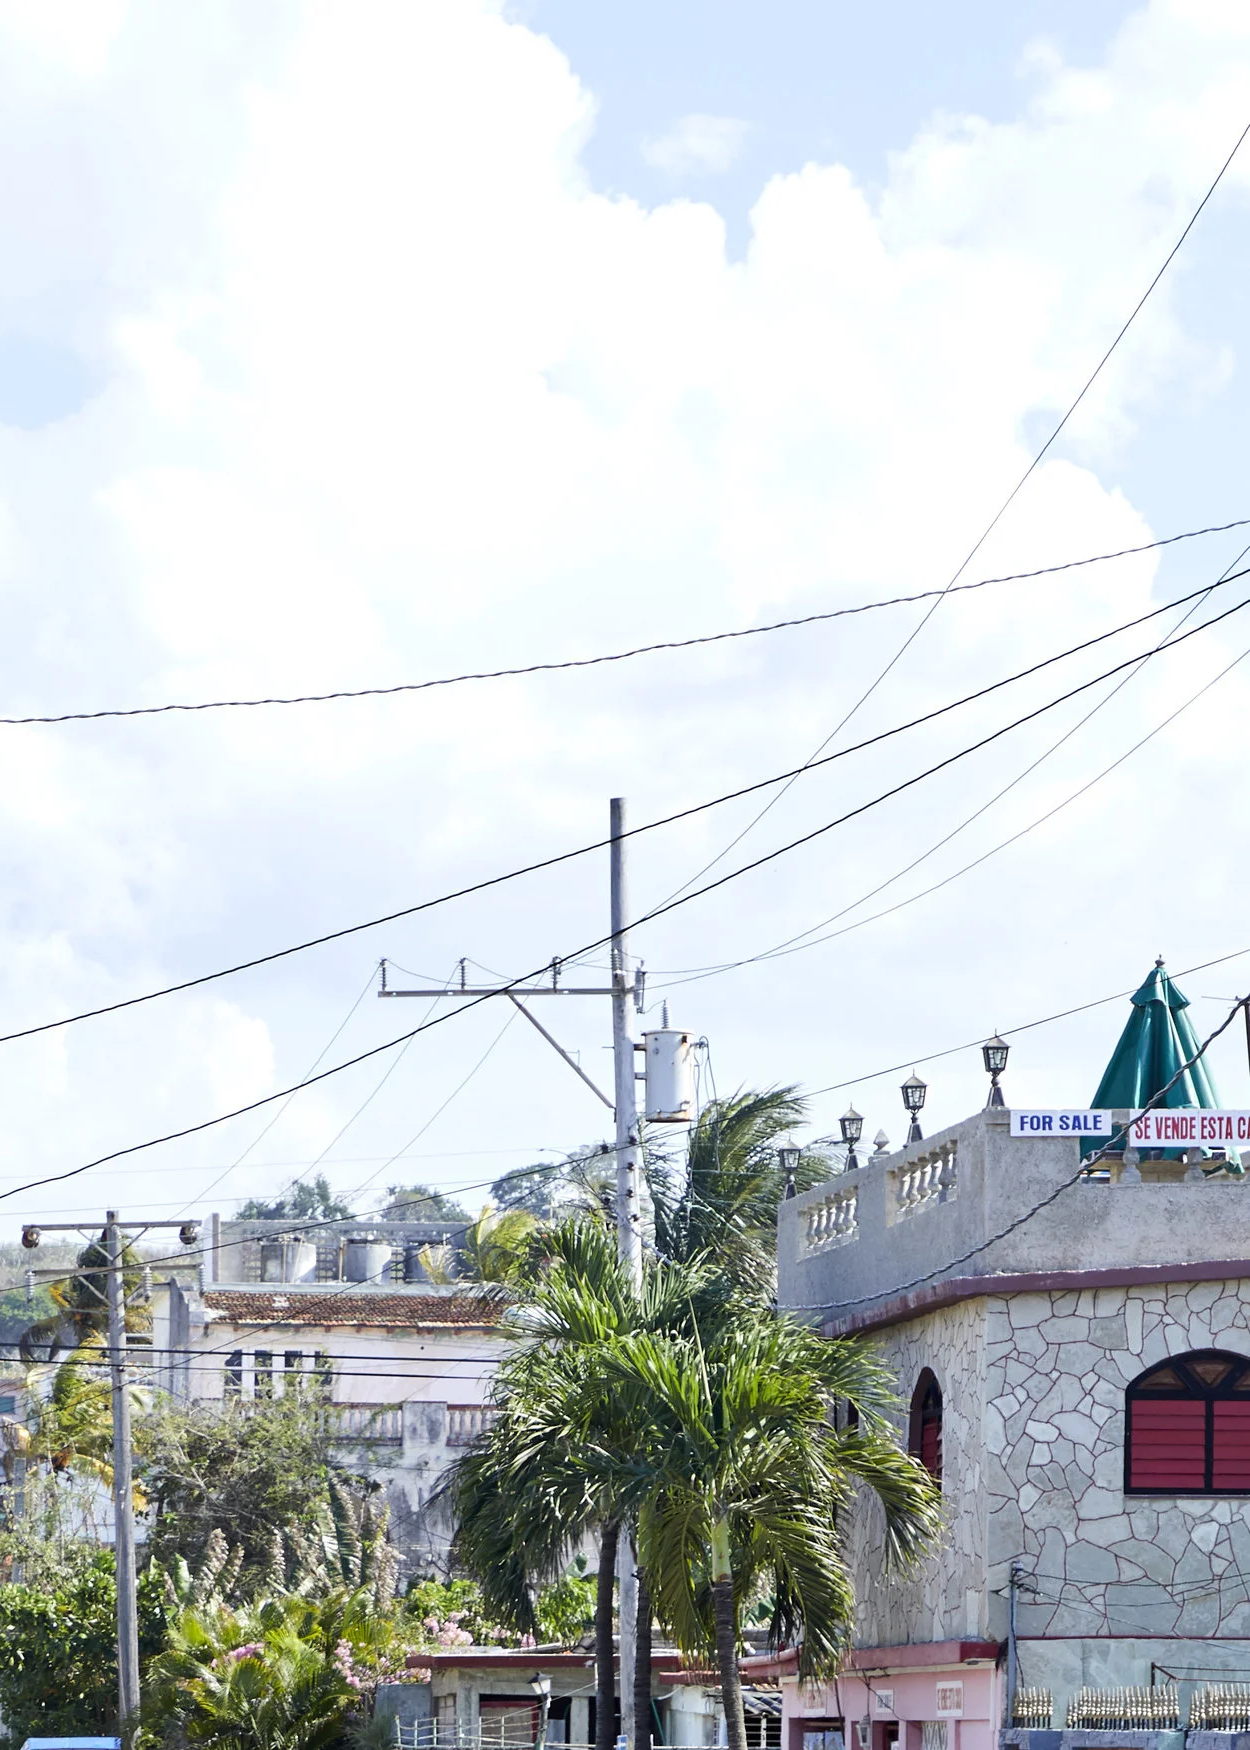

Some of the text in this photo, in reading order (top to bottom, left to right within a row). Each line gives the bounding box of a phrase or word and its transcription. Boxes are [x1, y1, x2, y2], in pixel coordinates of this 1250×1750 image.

[1020, 1115, 1102, 1131] FOR SALE
[1135, 1116, 1151, 1139] SE
[1155, 1116, 1197, 1139] VENDE
[1200, 1116, 1233, 1139] ESTA
